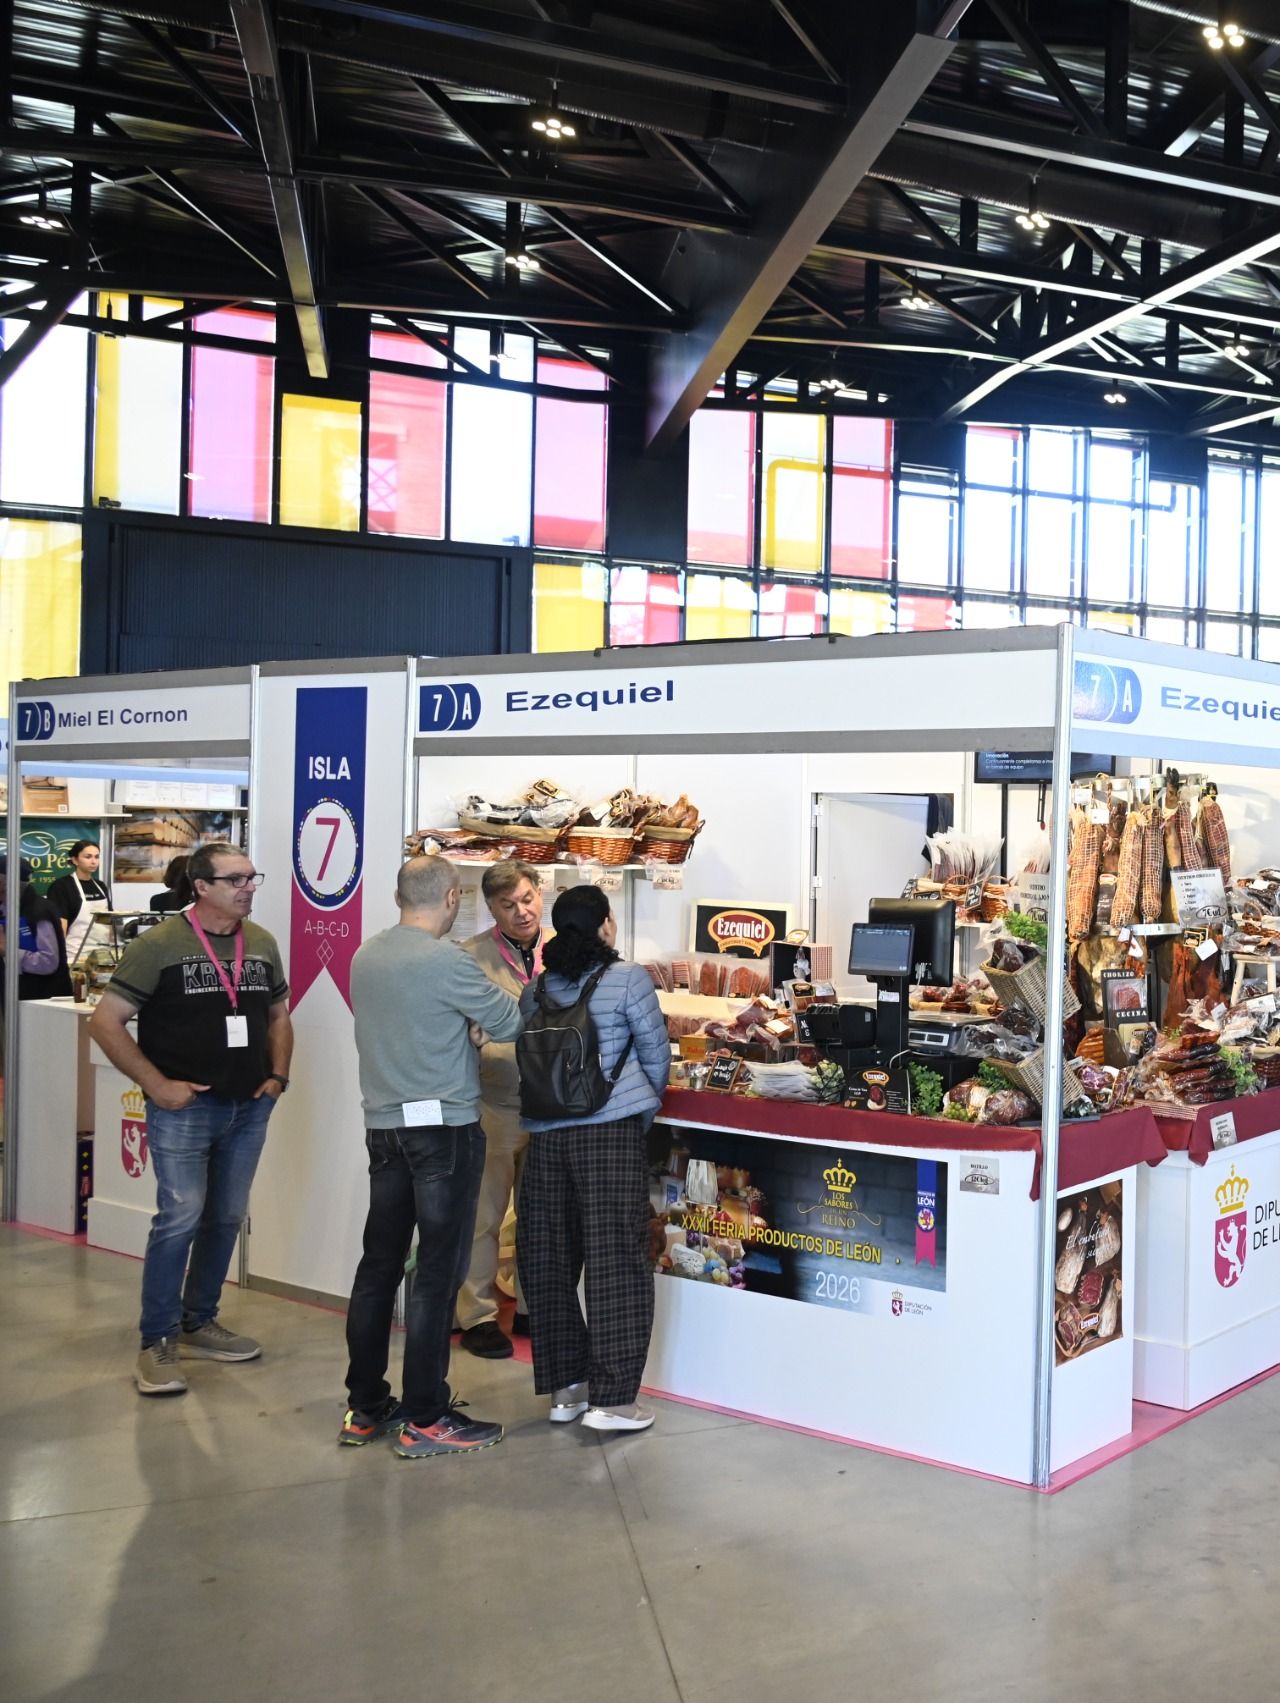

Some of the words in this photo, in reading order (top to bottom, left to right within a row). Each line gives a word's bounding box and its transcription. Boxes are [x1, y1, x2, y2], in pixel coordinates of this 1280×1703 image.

[506, 680, 674, 712] Ezequiel
[1090, 674, 1100, 704] 7
[1122, 679, 1133, 713] A
[433, 694, 442, 722] 7
[462, 692, 472, 720] A
[24, 709, 32, 733] 7
[58, 711, 91, 728] Miel
[98, 709, 114, 726] El
[120, 708, 188, 724] Cornon
[308, 756, 351, 780] ISLA
[314, 817, 341, 881] 7
[304, 918, 350, 938] A-B-C-D
[717, 918, 765, 939] Ezequiel
[1115, 1010, 1147, 1018] CECINA
[824, 1198, 853, 1210] SABORES
[832, 1191, 845, 1200] LOS
[917, 1195, 935, 1207] LEÓN
[822, 1214, 856, 1229] REINO
[681, 1214, 709, 1233] XXXII
[712, 1219, 746, 1239] FERIA
[749, 1228, 823, 1254] PRODUCTOS
[826, 1239, 842, 1257] DE
[847, 1241, 881, 1264] LEÓN
[1253, 1228, 1268, 1250] DE
[815, 1271, 860, 1304] 2026
[904, 1301, 932, 1311] DIPUTACIÓN
